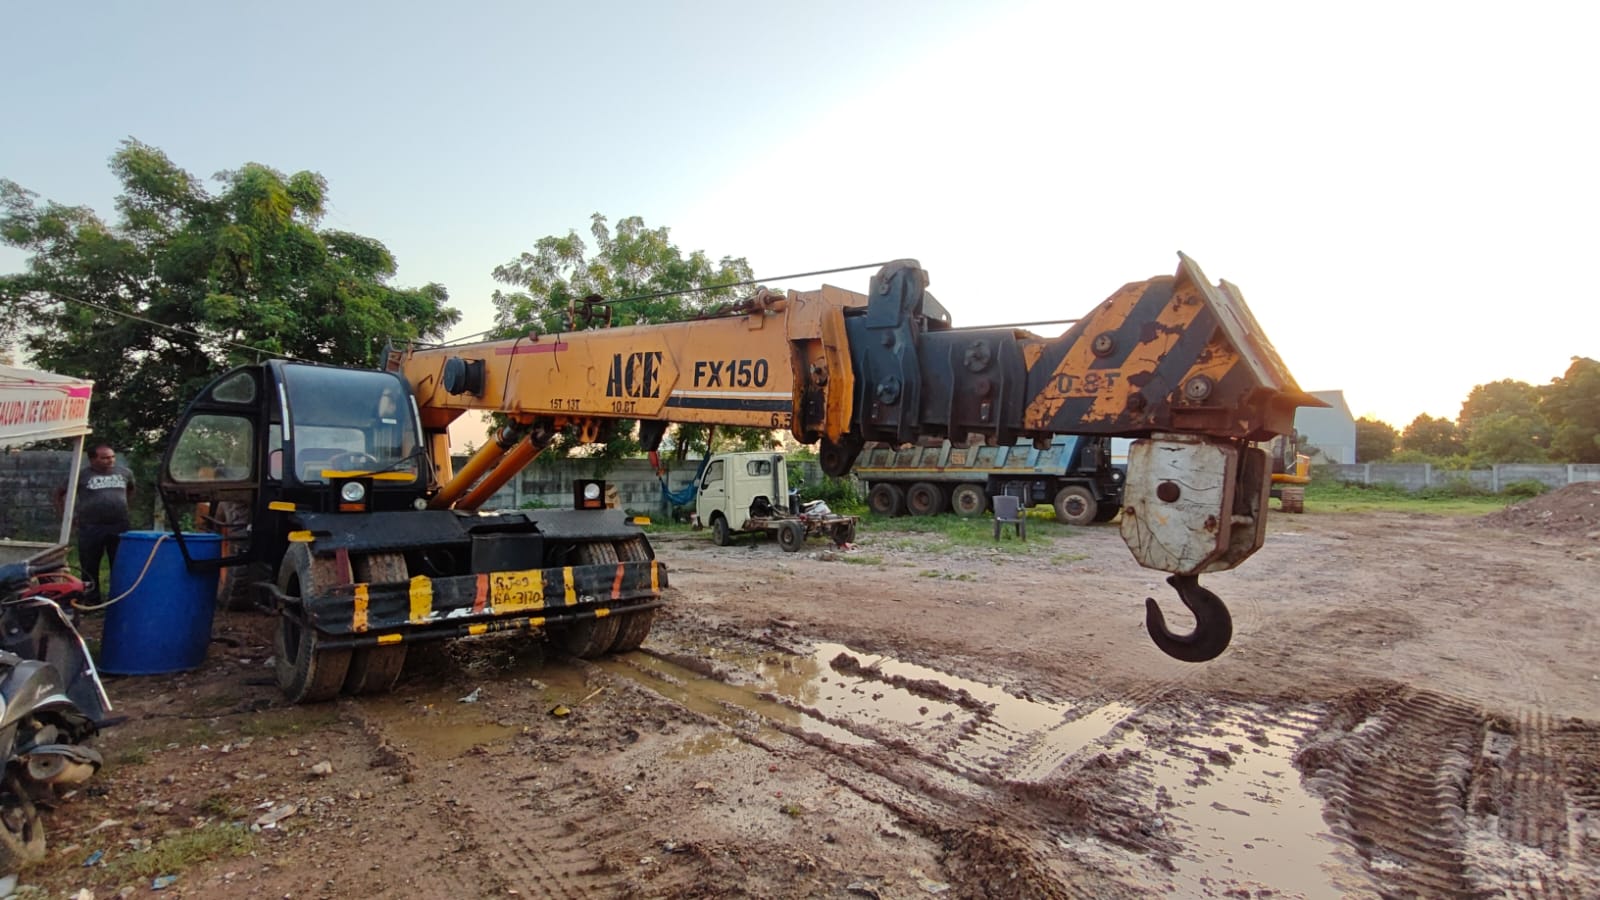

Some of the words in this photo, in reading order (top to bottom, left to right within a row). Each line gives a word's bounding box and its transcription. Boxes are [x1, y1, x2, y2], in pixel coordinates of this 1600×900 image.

[606, 351, 662, 398] ACE
[694, 358, 769, 388] FX150
[0, 401, 26, 426] ALUDA
[550, 398, 563, 410] 15T
